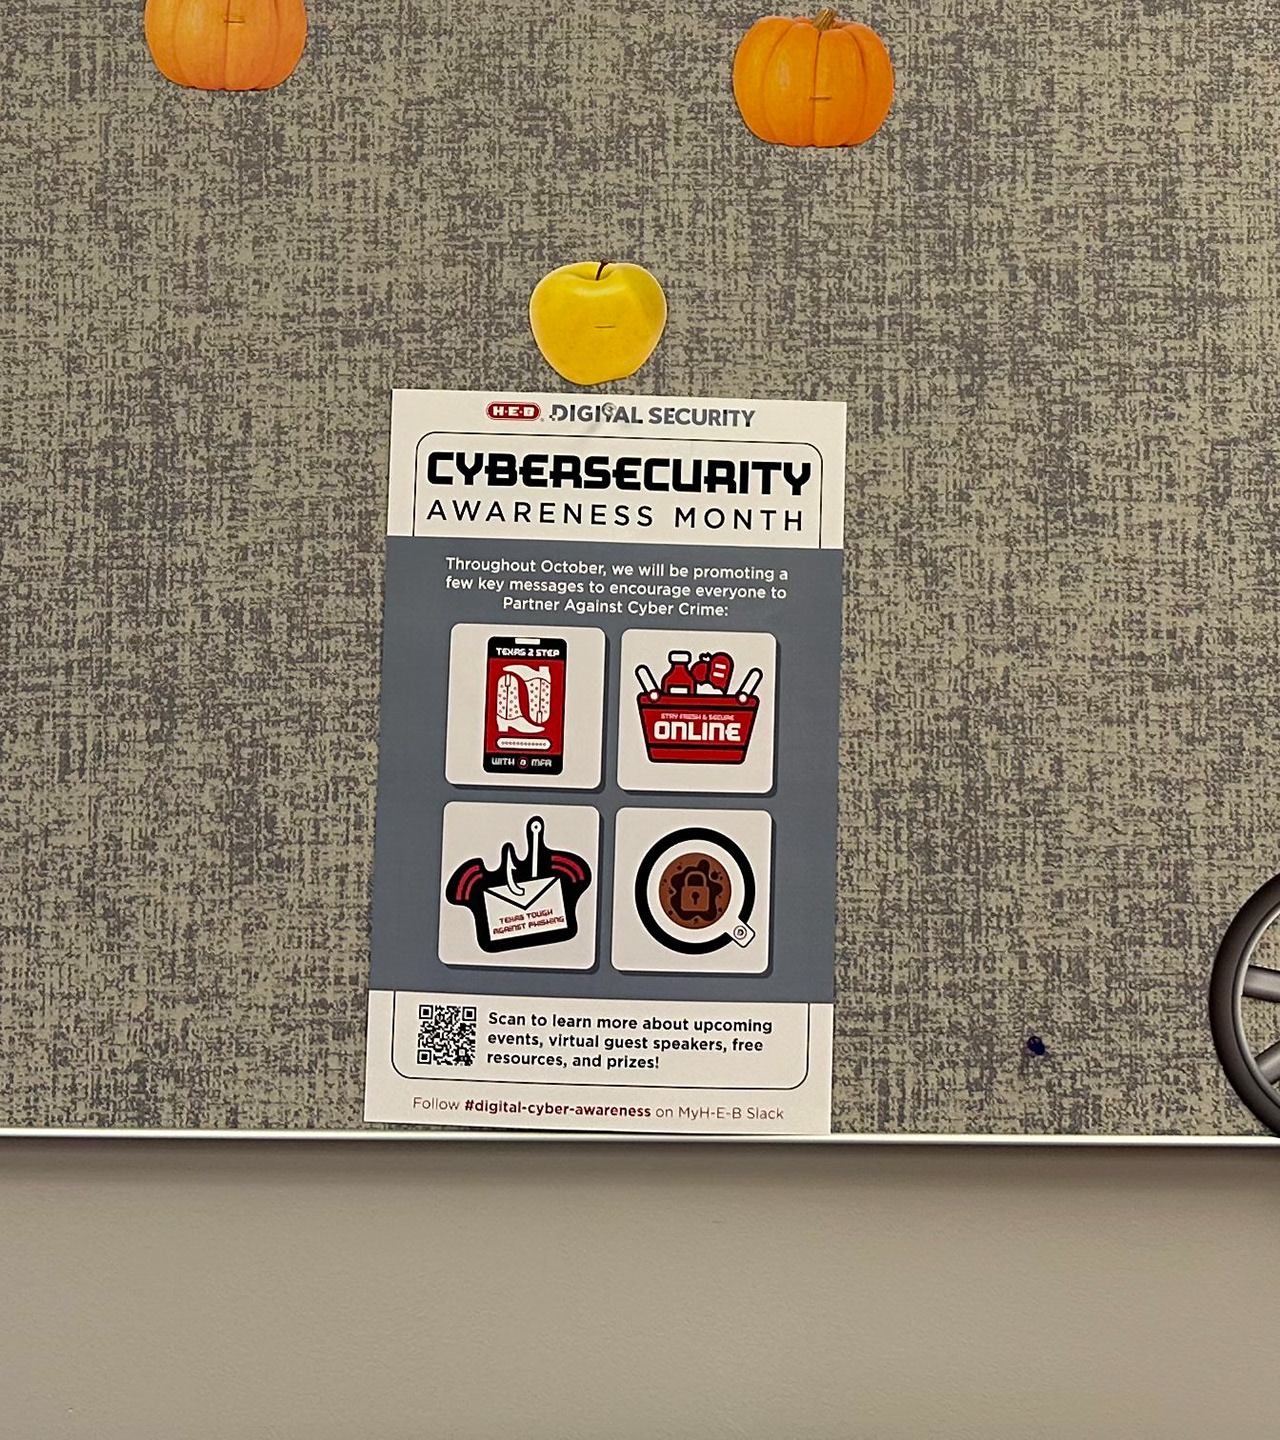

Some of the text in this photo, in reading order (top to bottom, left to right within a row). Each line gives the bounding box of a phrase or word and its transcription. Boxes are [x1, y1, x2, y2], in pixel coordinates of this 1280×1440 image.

[648, 407, 756, 428] SECURITY
[427, 451, 811, 496] CYBERSECURITY
[426, 499, 802, 532] AWARENESS MONTH
[445, 557, 788, 583] Throughout October, we will be promoting a
[503, 596, 729, 617] Partner Against Cyber Crime:
[654, 720, 741, 742] ONLINE
[488, 1011, 772, 1035] Scan to learn more about upcoming
[487, 1033, 763, 1053] events, virtual guest speakers, free
[487, 1053, 659, 1070] resources, and prizes!
[412, 1096, 784, 1121] Follow #digital-cyber-awareness on MyH-E-B Slack
